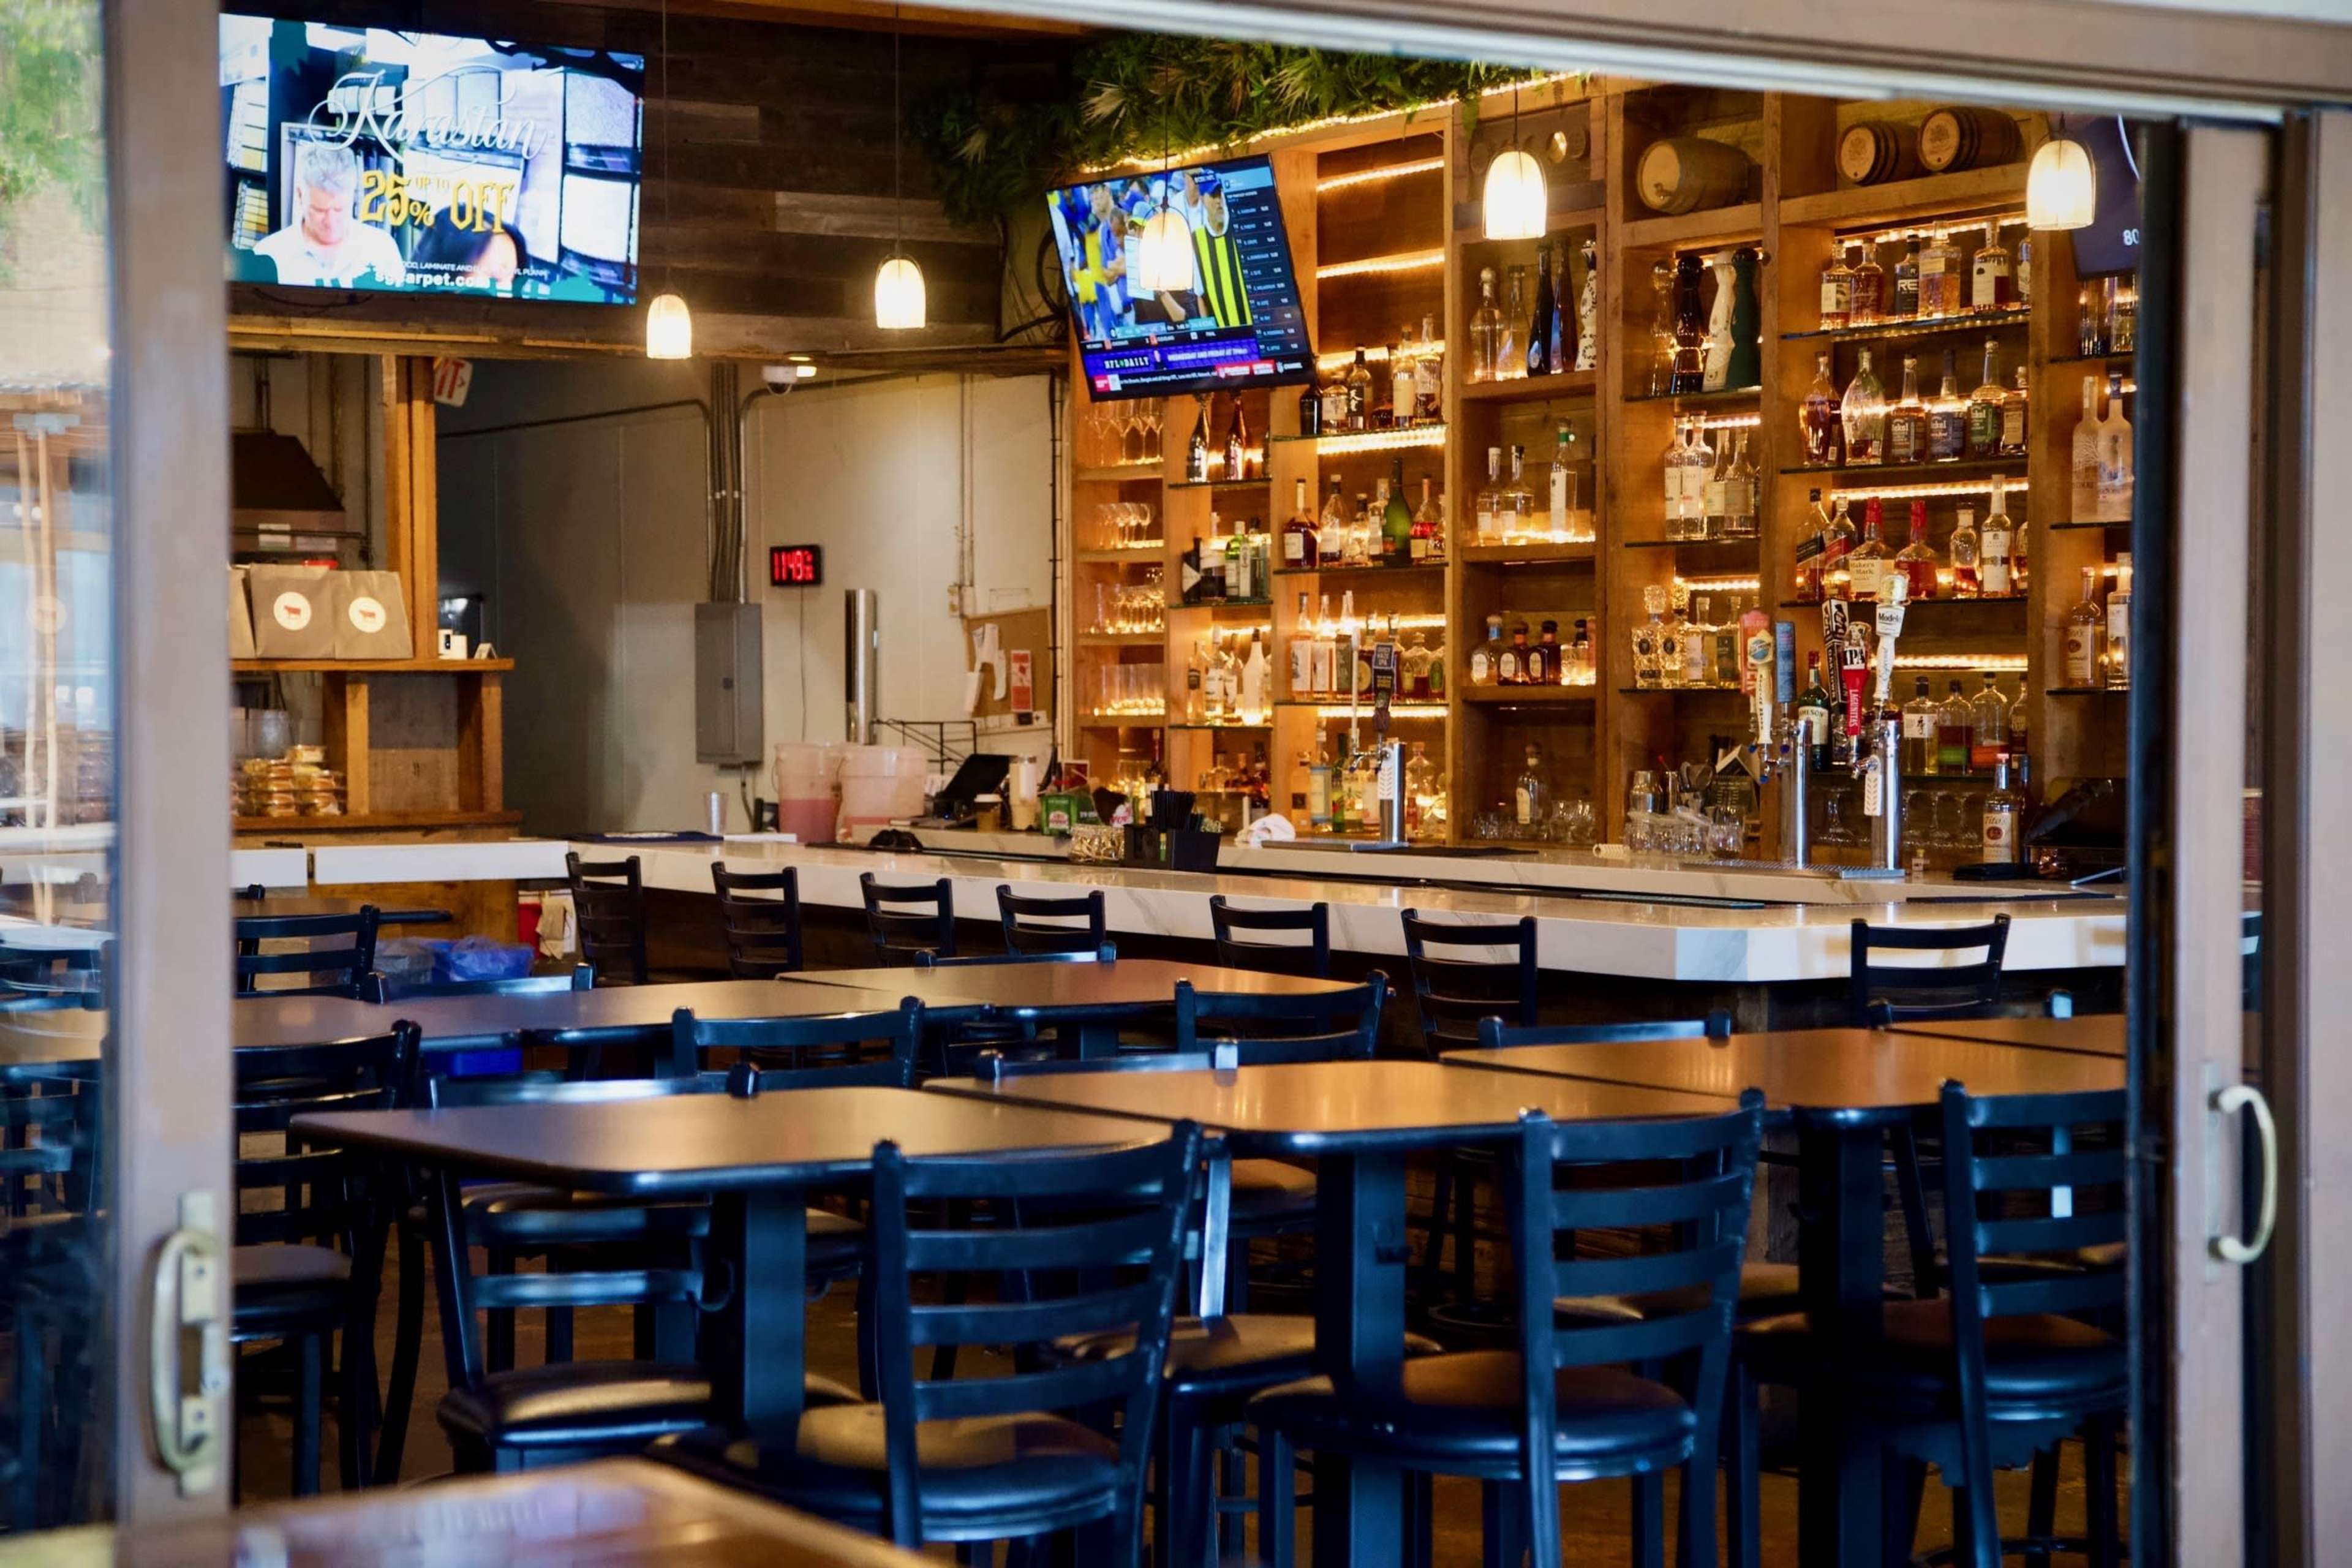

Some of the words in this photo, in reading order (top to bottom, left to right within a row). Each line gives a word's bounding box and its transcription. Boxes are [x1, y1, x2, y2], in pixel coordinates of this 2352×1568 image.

[307, 64, 548, 162] Karastan
[360, 169, 435, 227] 25%
[450, 178, 515, 234] OFF
[1123, 355, 1149, 368] DAILY
[1879, 612, 1902, 623] Modelo
[1844, 649, 1865, 666] IPA
[1849, 689, 1859, 728] LAGUNITAS
